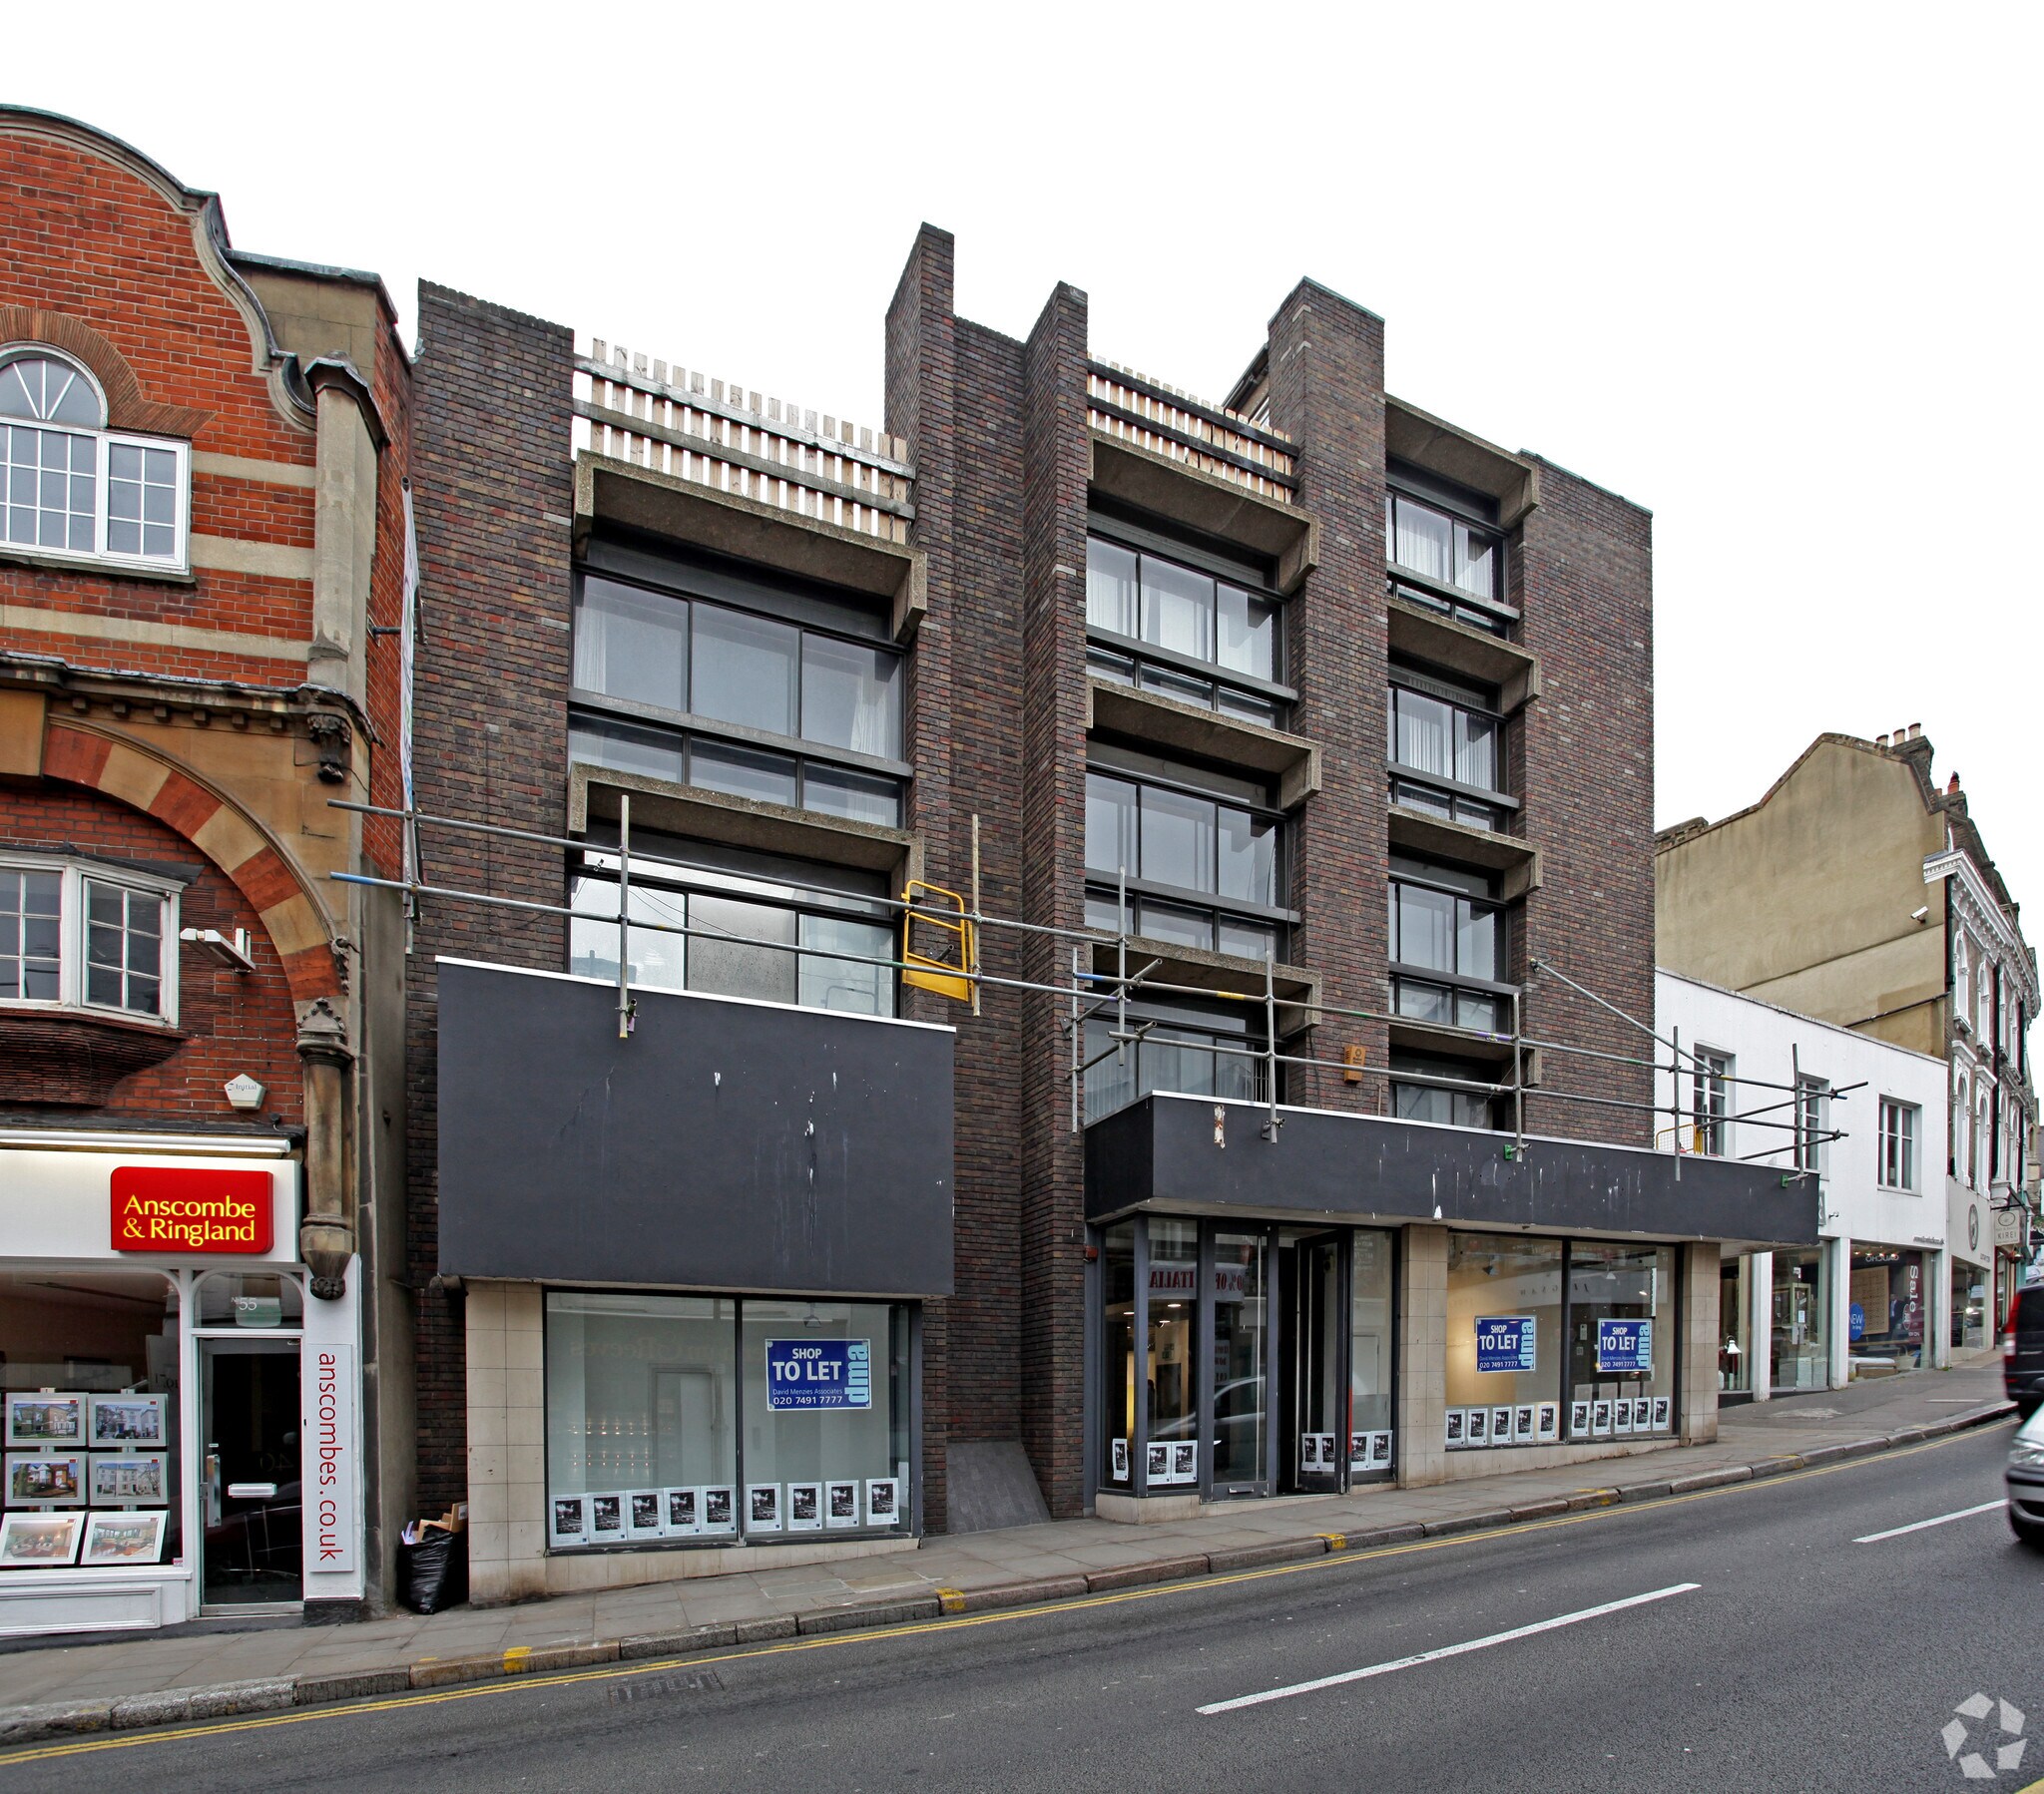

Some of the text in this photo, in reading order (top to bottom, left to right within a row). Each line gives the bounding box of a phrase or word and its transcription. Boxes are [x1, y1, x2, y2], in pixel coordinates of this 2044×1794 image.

[124, 1194, 256, 1218] Anscombe
[123, 1217, 255, 1246] & Ringland
[1909, 1265, 1918, 1313] Sale
[239, 1297, 257, 1311] 55
[1490, 1325, 1507, 1334] SHOP
[792, 1348, 822, 1359] SHOP
[1479, 1334, 1518, 1351] TO LET
[1518, 1321, 1534, 1366] dma
[1602, 1336, 1636, 1351] TO LET
[1636, 1324, 1650, 1367] dma
[771, 1361, 842, 1381] TO LET
[843, 1344, 869, 1403] dma
[795, 1396, 816, 1405] 7491
[819, 1395, 843, 1404] 7777
[318, 1352, 343, 1562] anscombes.co.uk
